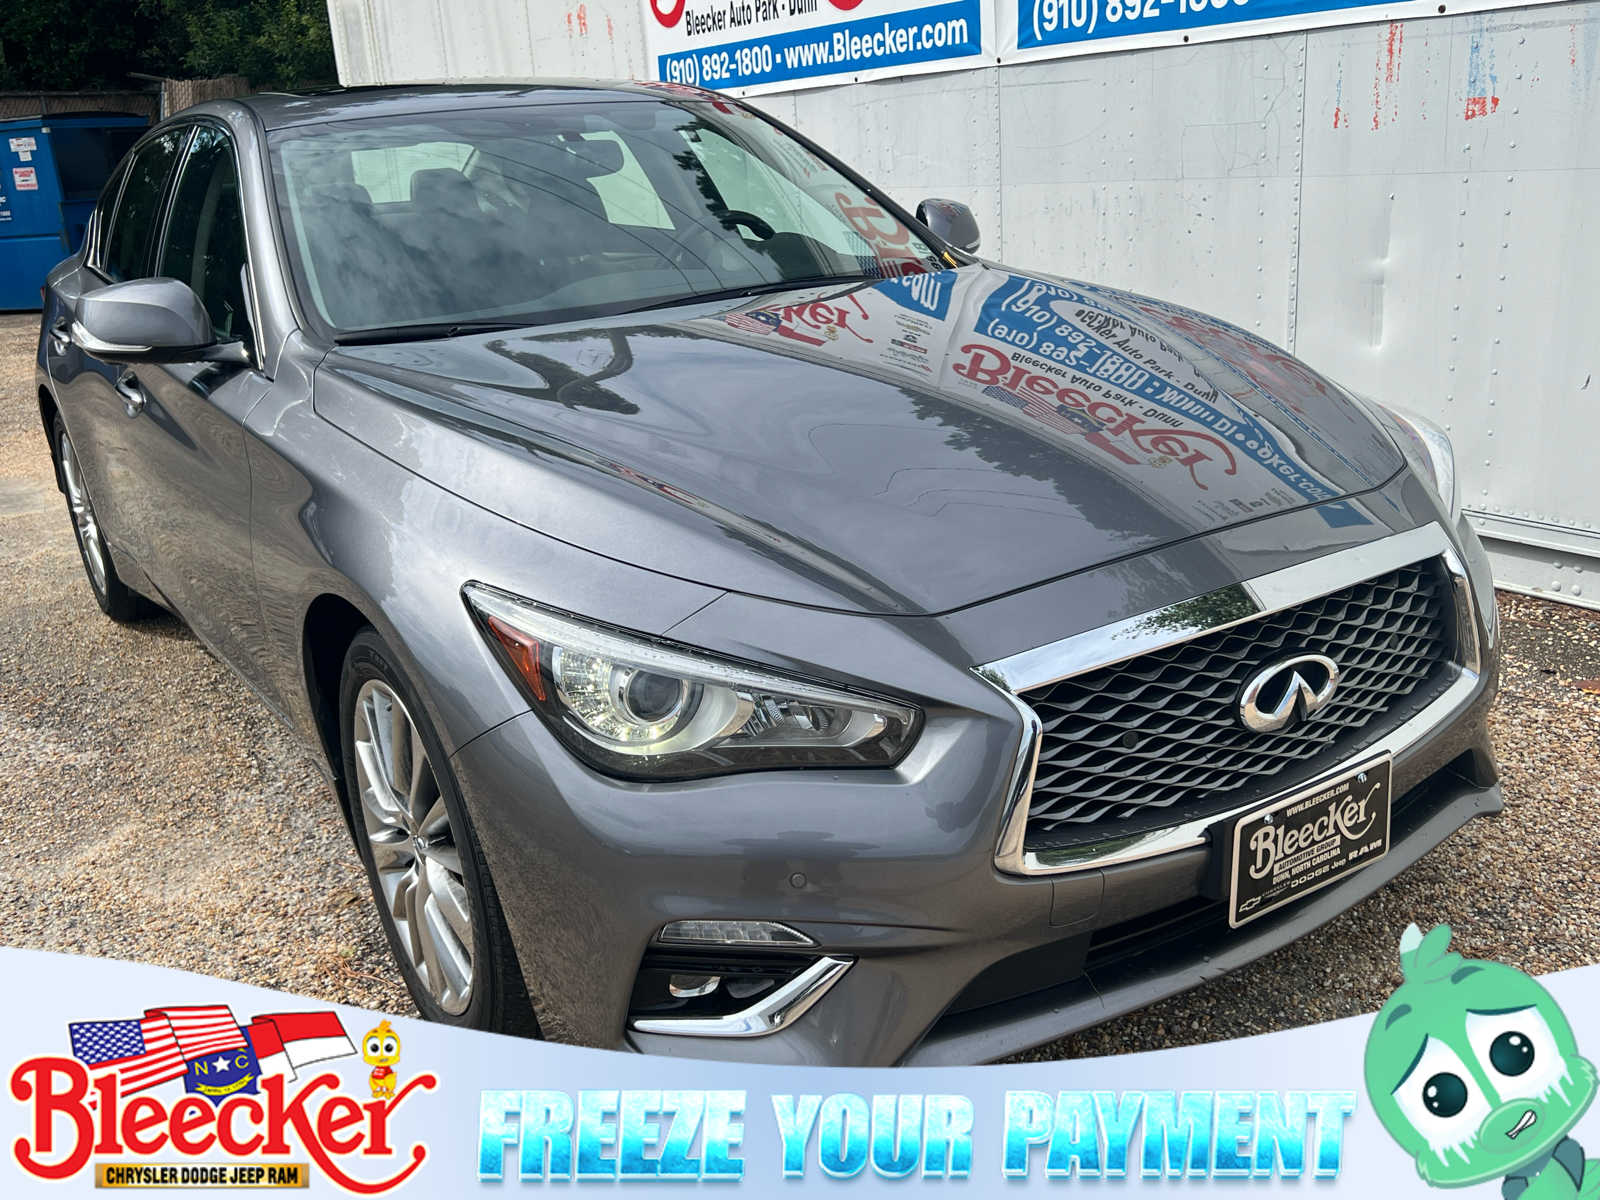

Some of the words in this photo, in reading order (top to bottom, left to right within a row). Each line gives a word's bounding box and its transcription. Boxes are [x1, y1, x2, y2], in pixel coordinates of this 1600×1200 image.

[685, 6, 726, 36] Bleecker
[730, 1, 752, 28] Auto
[755, 0, 779, 23] Park
[1032, 0, 1098, 41] (910)
[1105, 0, 1249, 23] 892-
[666, 54, 700, 87] (910)
[702, 44, 772, 82] 892-1800
[784, 18, 968, 70] www.Bleecker.com
[1113, 338, 1144, 360] Auto
[1143, 358, 1175, 380] Park
[1287, 783, 1350, 817] WWW.BLEECKER.COM
[1250, 782, 1381, 880] Bleecker
[1278, 847, 1316, 871] AUTOMOTIVE
[1316, 839, 1337, 856] GROUP
[1291, 864, 1330, 888] DODGE
[1331, 858, 1347, 872] Jeep
[1348, 839, 1383, 861] RAM
[1312, 847, 1341, 868] CAROLINA
